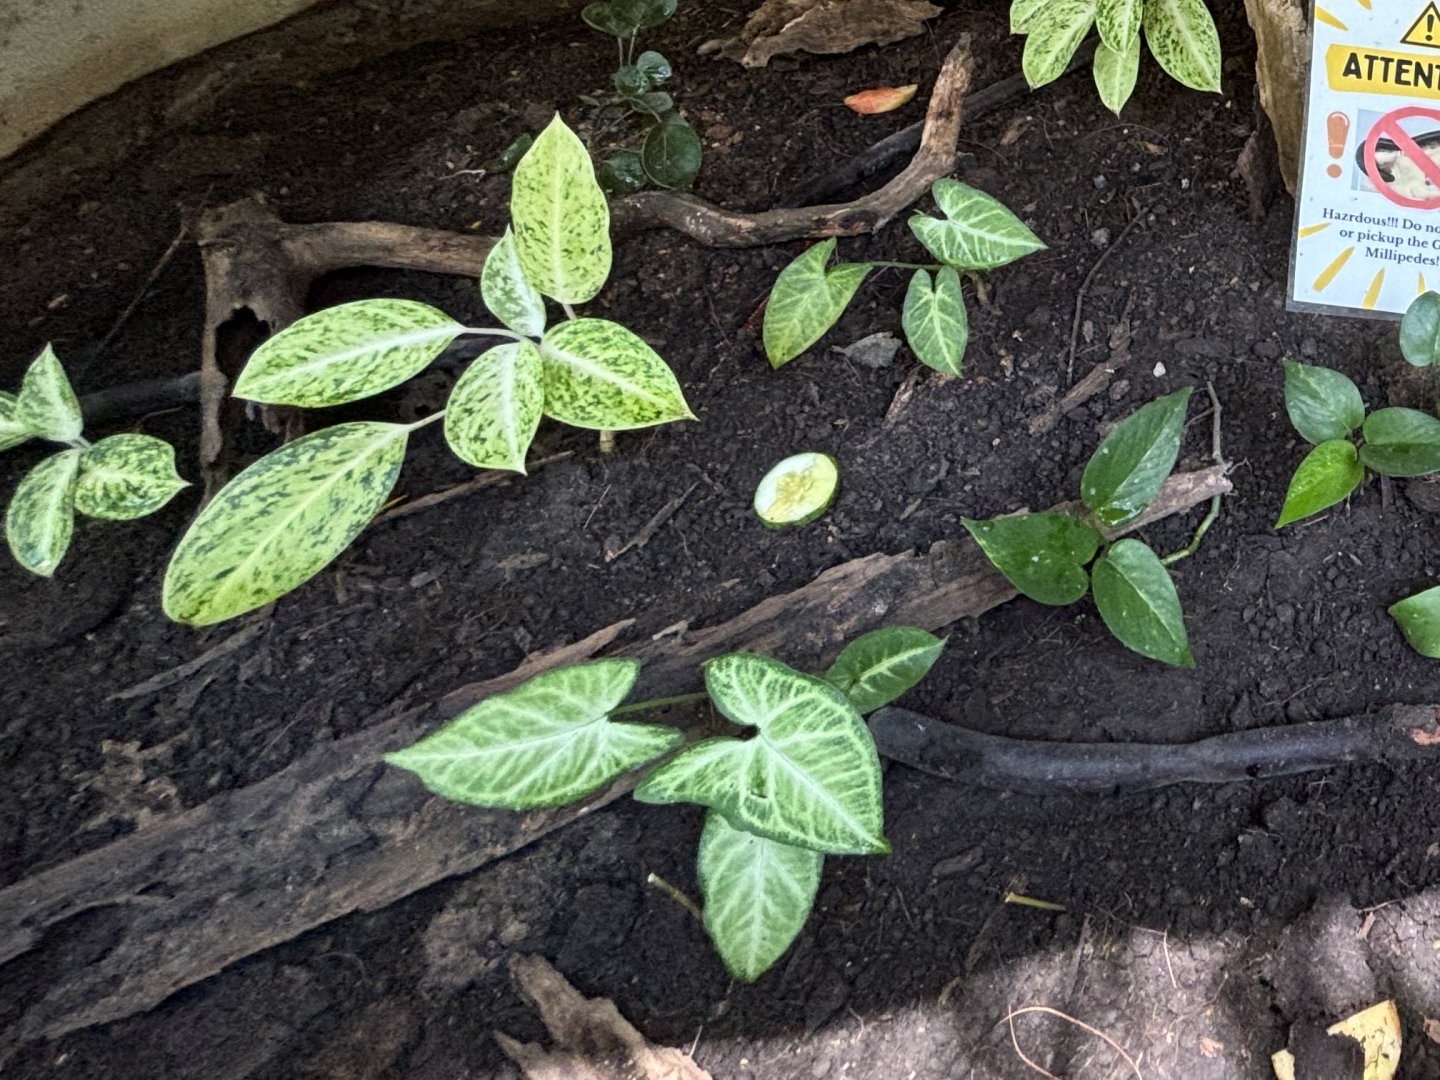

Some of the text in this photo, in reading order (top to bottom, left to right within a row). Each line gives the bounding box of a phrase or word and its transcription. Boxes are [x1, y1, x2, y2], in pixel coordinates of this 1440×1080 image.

[1323, 207, 1399, 229] Hazrdous!!!
[1402, 218, 1422, 231] Do
[1339, 228, 1354, 238] or
[1357, 229, 1404, 247] pickup
[1407, 234, 1429, 249] the
[1365, 246, 1440, 267] Millipedes!
